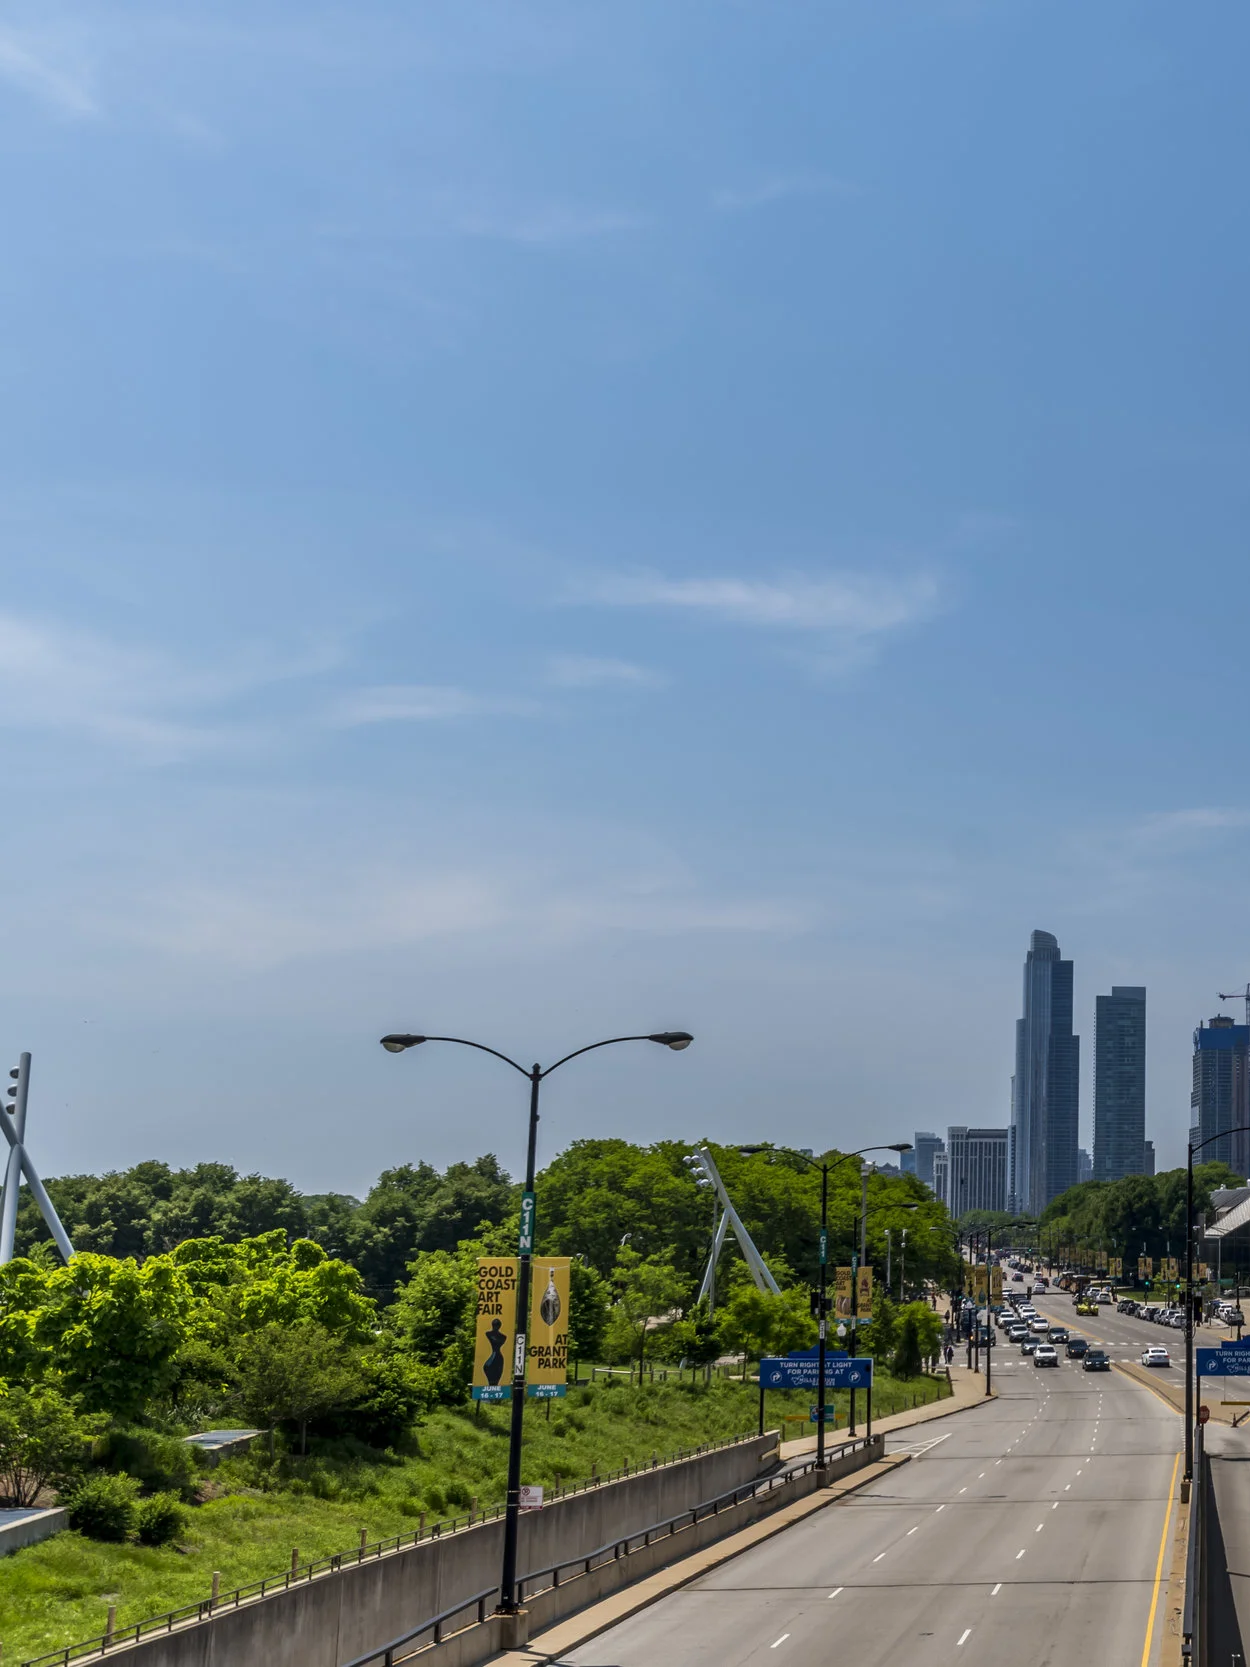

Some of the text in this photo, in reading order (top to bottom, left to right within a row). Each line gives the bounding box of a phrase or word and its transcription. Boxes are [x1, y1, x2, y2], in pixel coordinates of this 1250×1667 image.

[520, 1198, 533, 1248] C11N
[479, 1266, 514, 1277] GOLD
[478, 1279, 517, 1290] COAST
[478, 1291, 501, 1302] ART
[477, 1303, 503, 1315] FAIR
[555, 1334, 568, 1345] AT
[515, 1336, 525, 1373] C11N
[530, 1346, 568, 1357] GRANT
[538, 1358, 566, 1369] PARK
